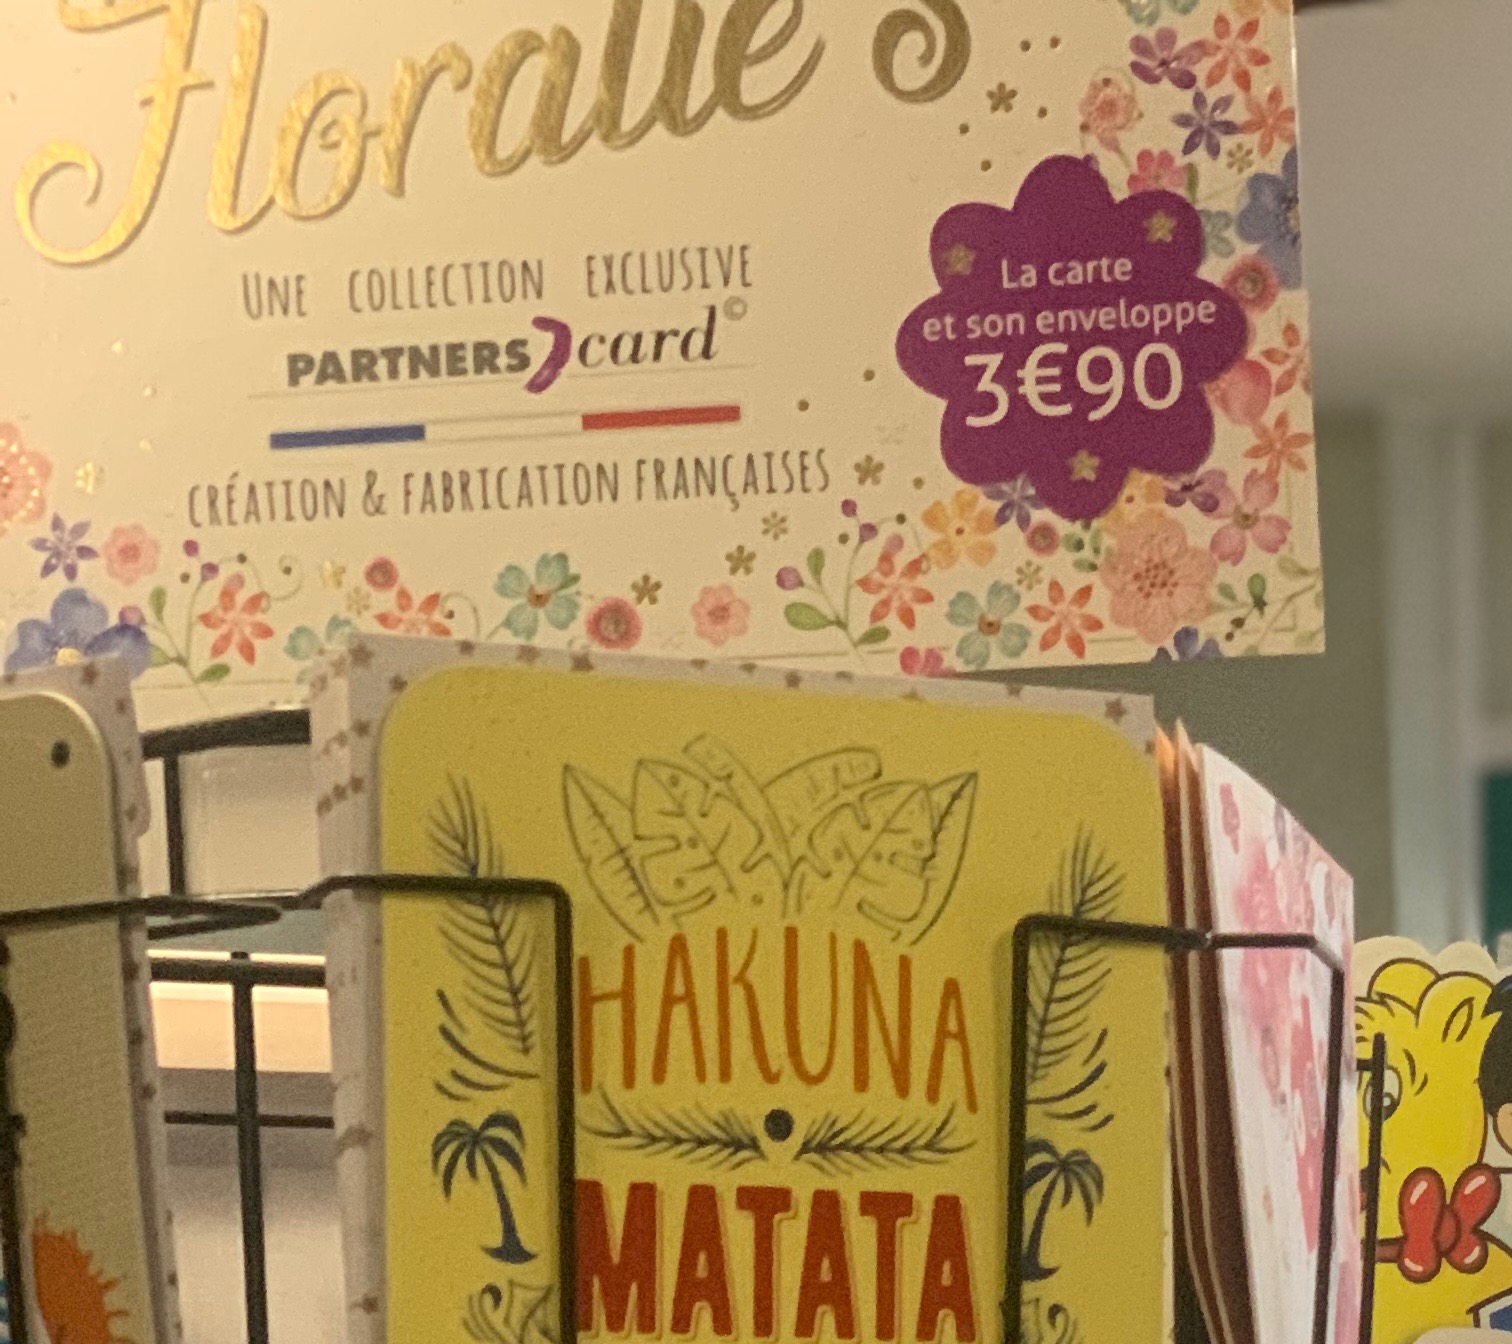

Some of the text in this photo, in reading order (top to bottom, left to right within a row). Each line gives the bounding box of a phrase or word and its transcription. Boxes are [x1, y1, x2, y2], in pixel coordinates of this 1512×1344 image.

[348, 258, 546, 313] COLLECTION
[585, 244, 753, 298] EXCLUSIVE
[1001, 256, 1133, 289] La carte
[286, 304, 719, 387] PARTNERS card
[922, 298, 1217, 341] et son enveloppe
[963, 341, 1183, 428] 3€90
[187, 446, 831, 529] CRÉATION & FABRICATION FRANÇAISES
[577, 926, 979, 1114] HAKUNA
[574, 1177, 981, 1344] MATATA
